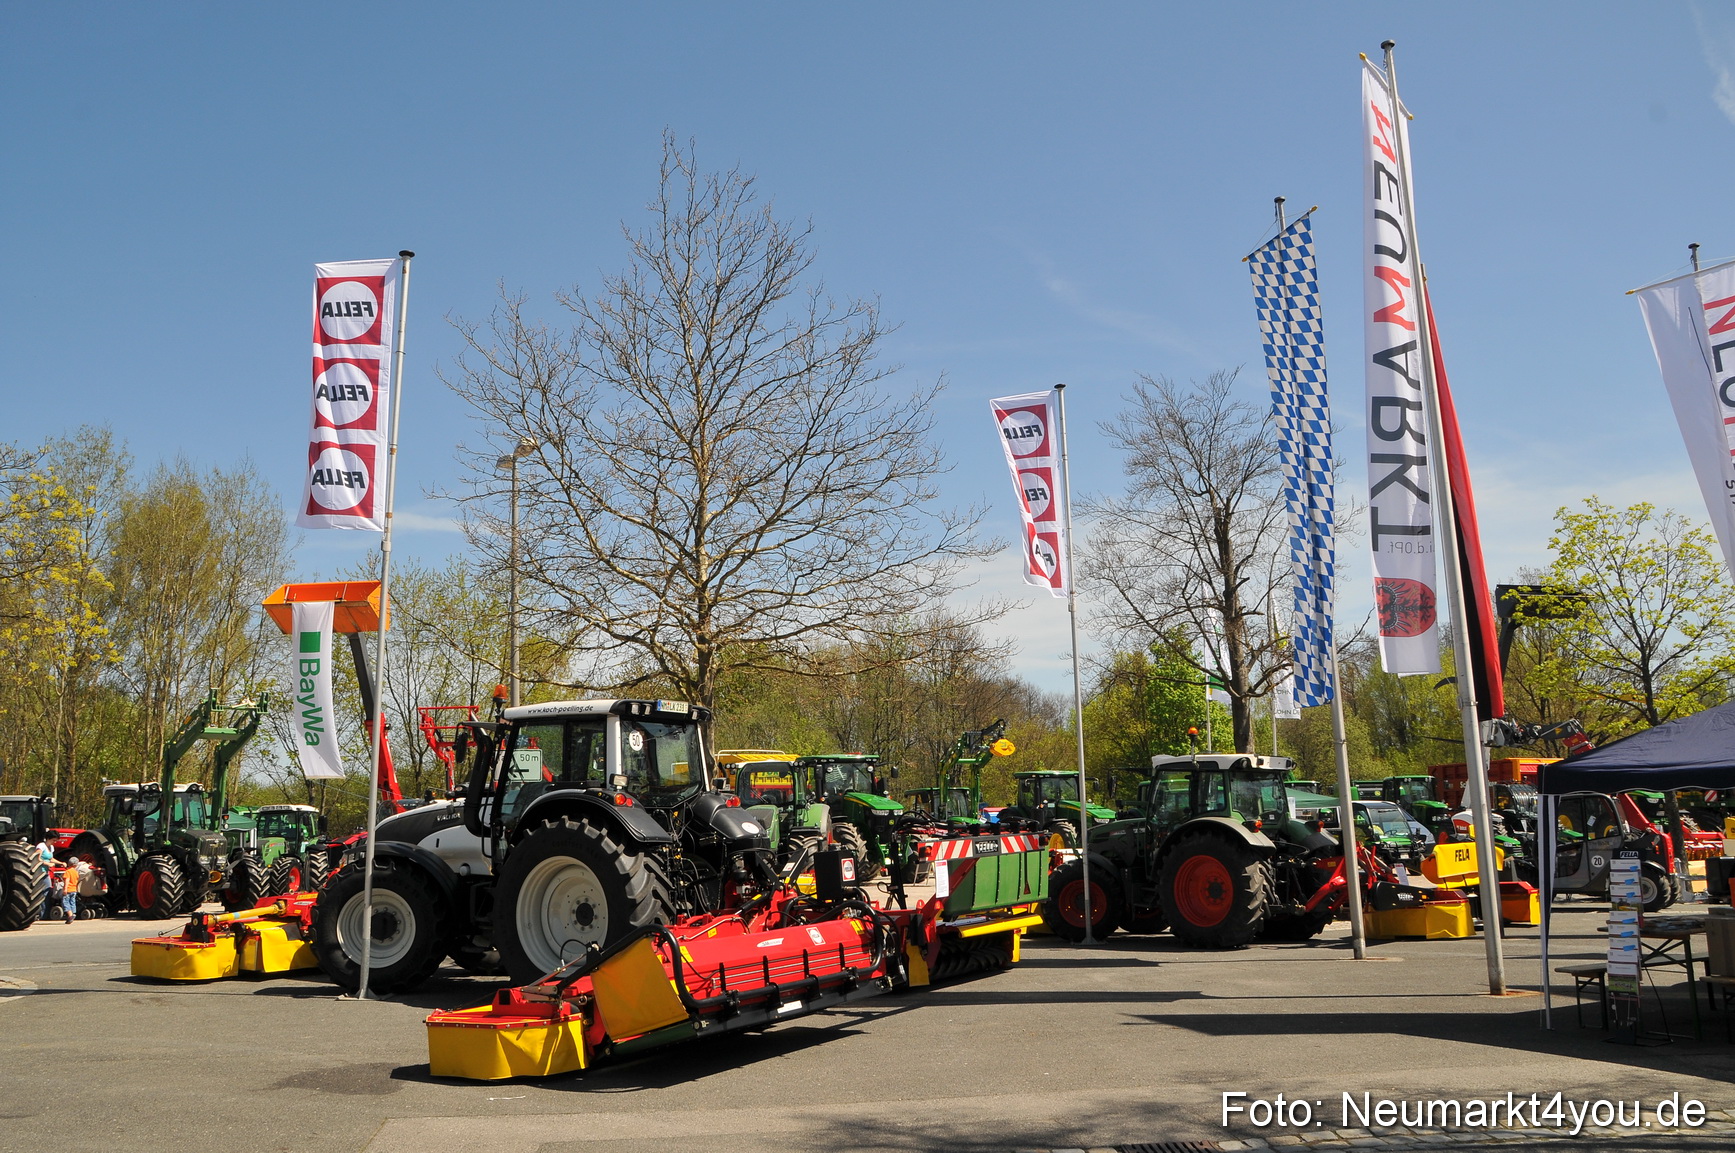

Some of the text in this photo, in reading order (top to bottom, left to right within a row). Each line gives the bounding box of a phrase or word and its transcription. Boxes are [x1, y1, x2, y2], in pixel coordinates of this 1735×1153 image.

[297, 658, 325, 746] BayWa
[632, 734, 640, 747] 50
[520, 753, 530, 762] 50
[1593, 857, 1602, 866] 20
